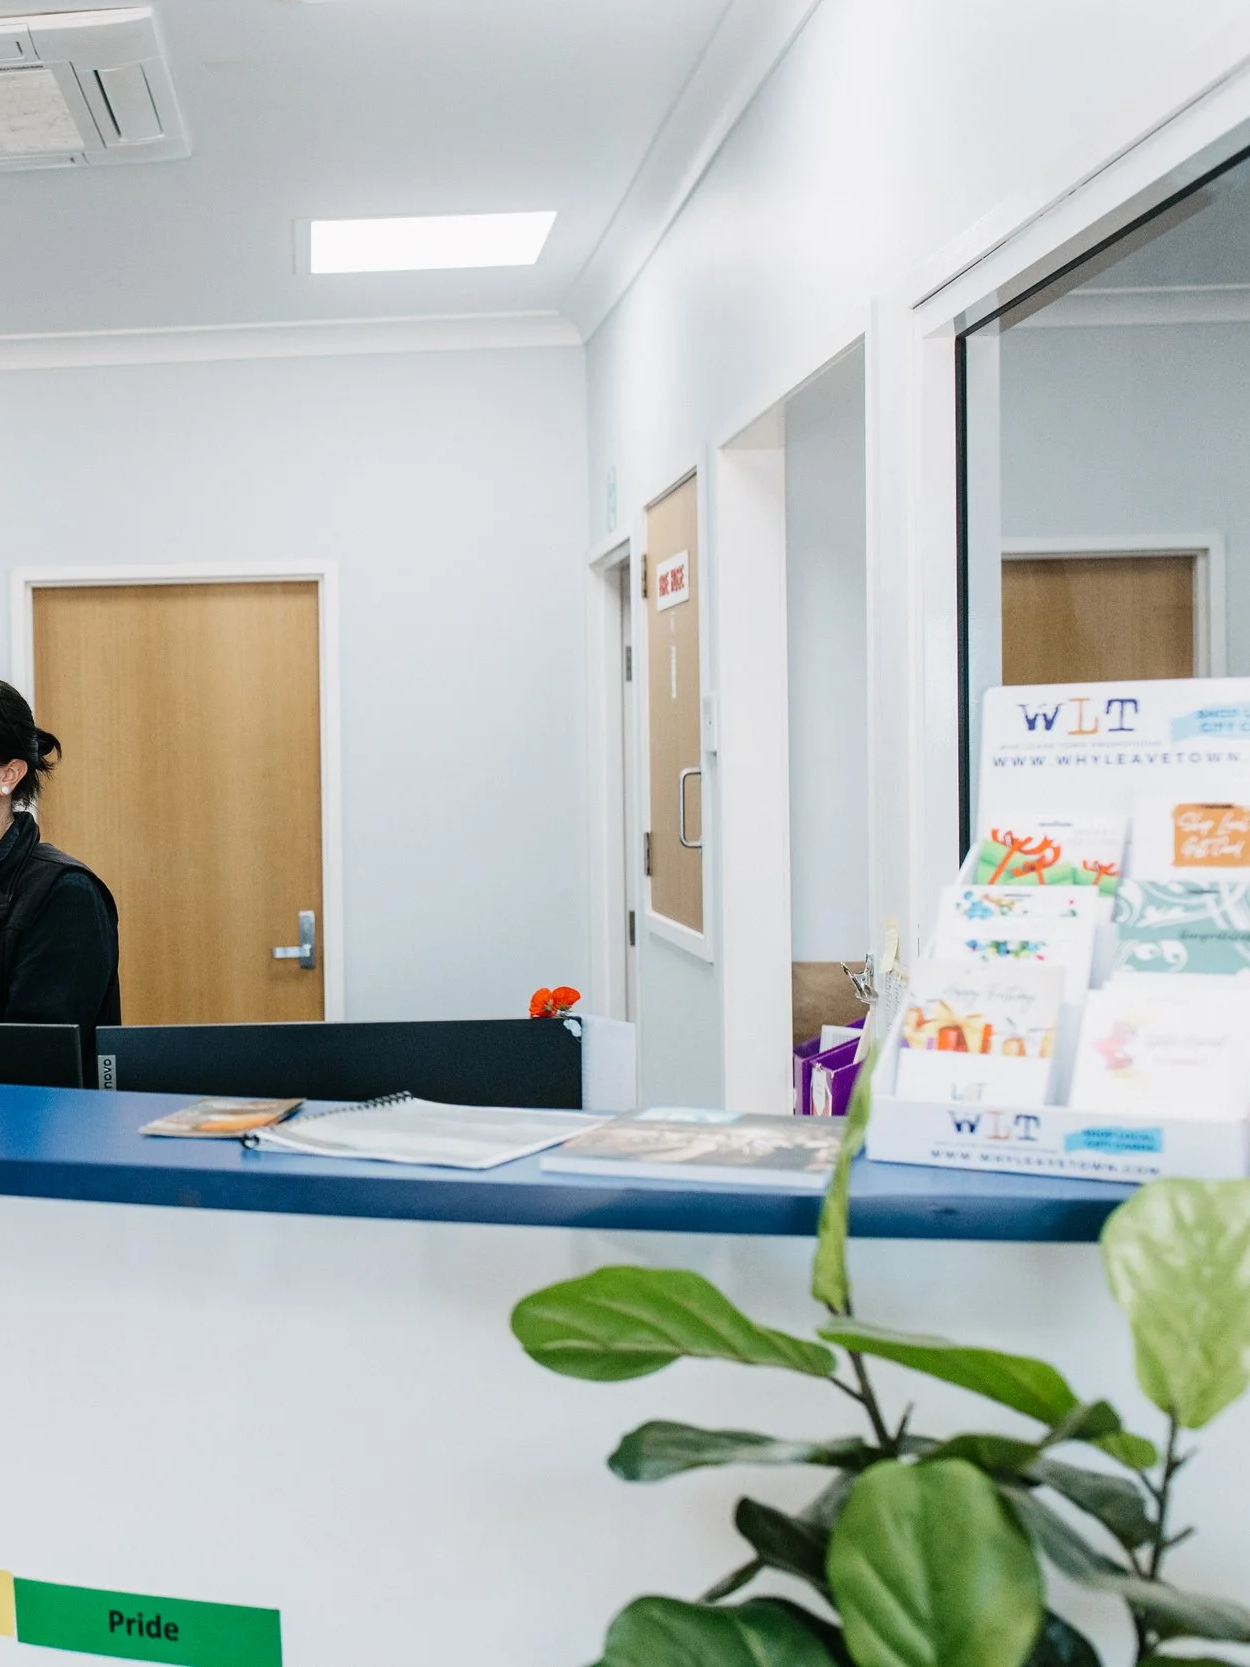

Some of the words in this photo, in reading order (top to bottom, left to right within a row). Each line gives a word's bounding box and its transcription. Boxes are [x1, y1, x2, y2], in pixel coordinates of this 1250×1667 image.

[1017, 698, 1139, 736] WLT
[103, 1058, 112, 1090] novo
[947, 1109, 1042, 1142] WLT
[108, 1609, 180, 1642] Pride
